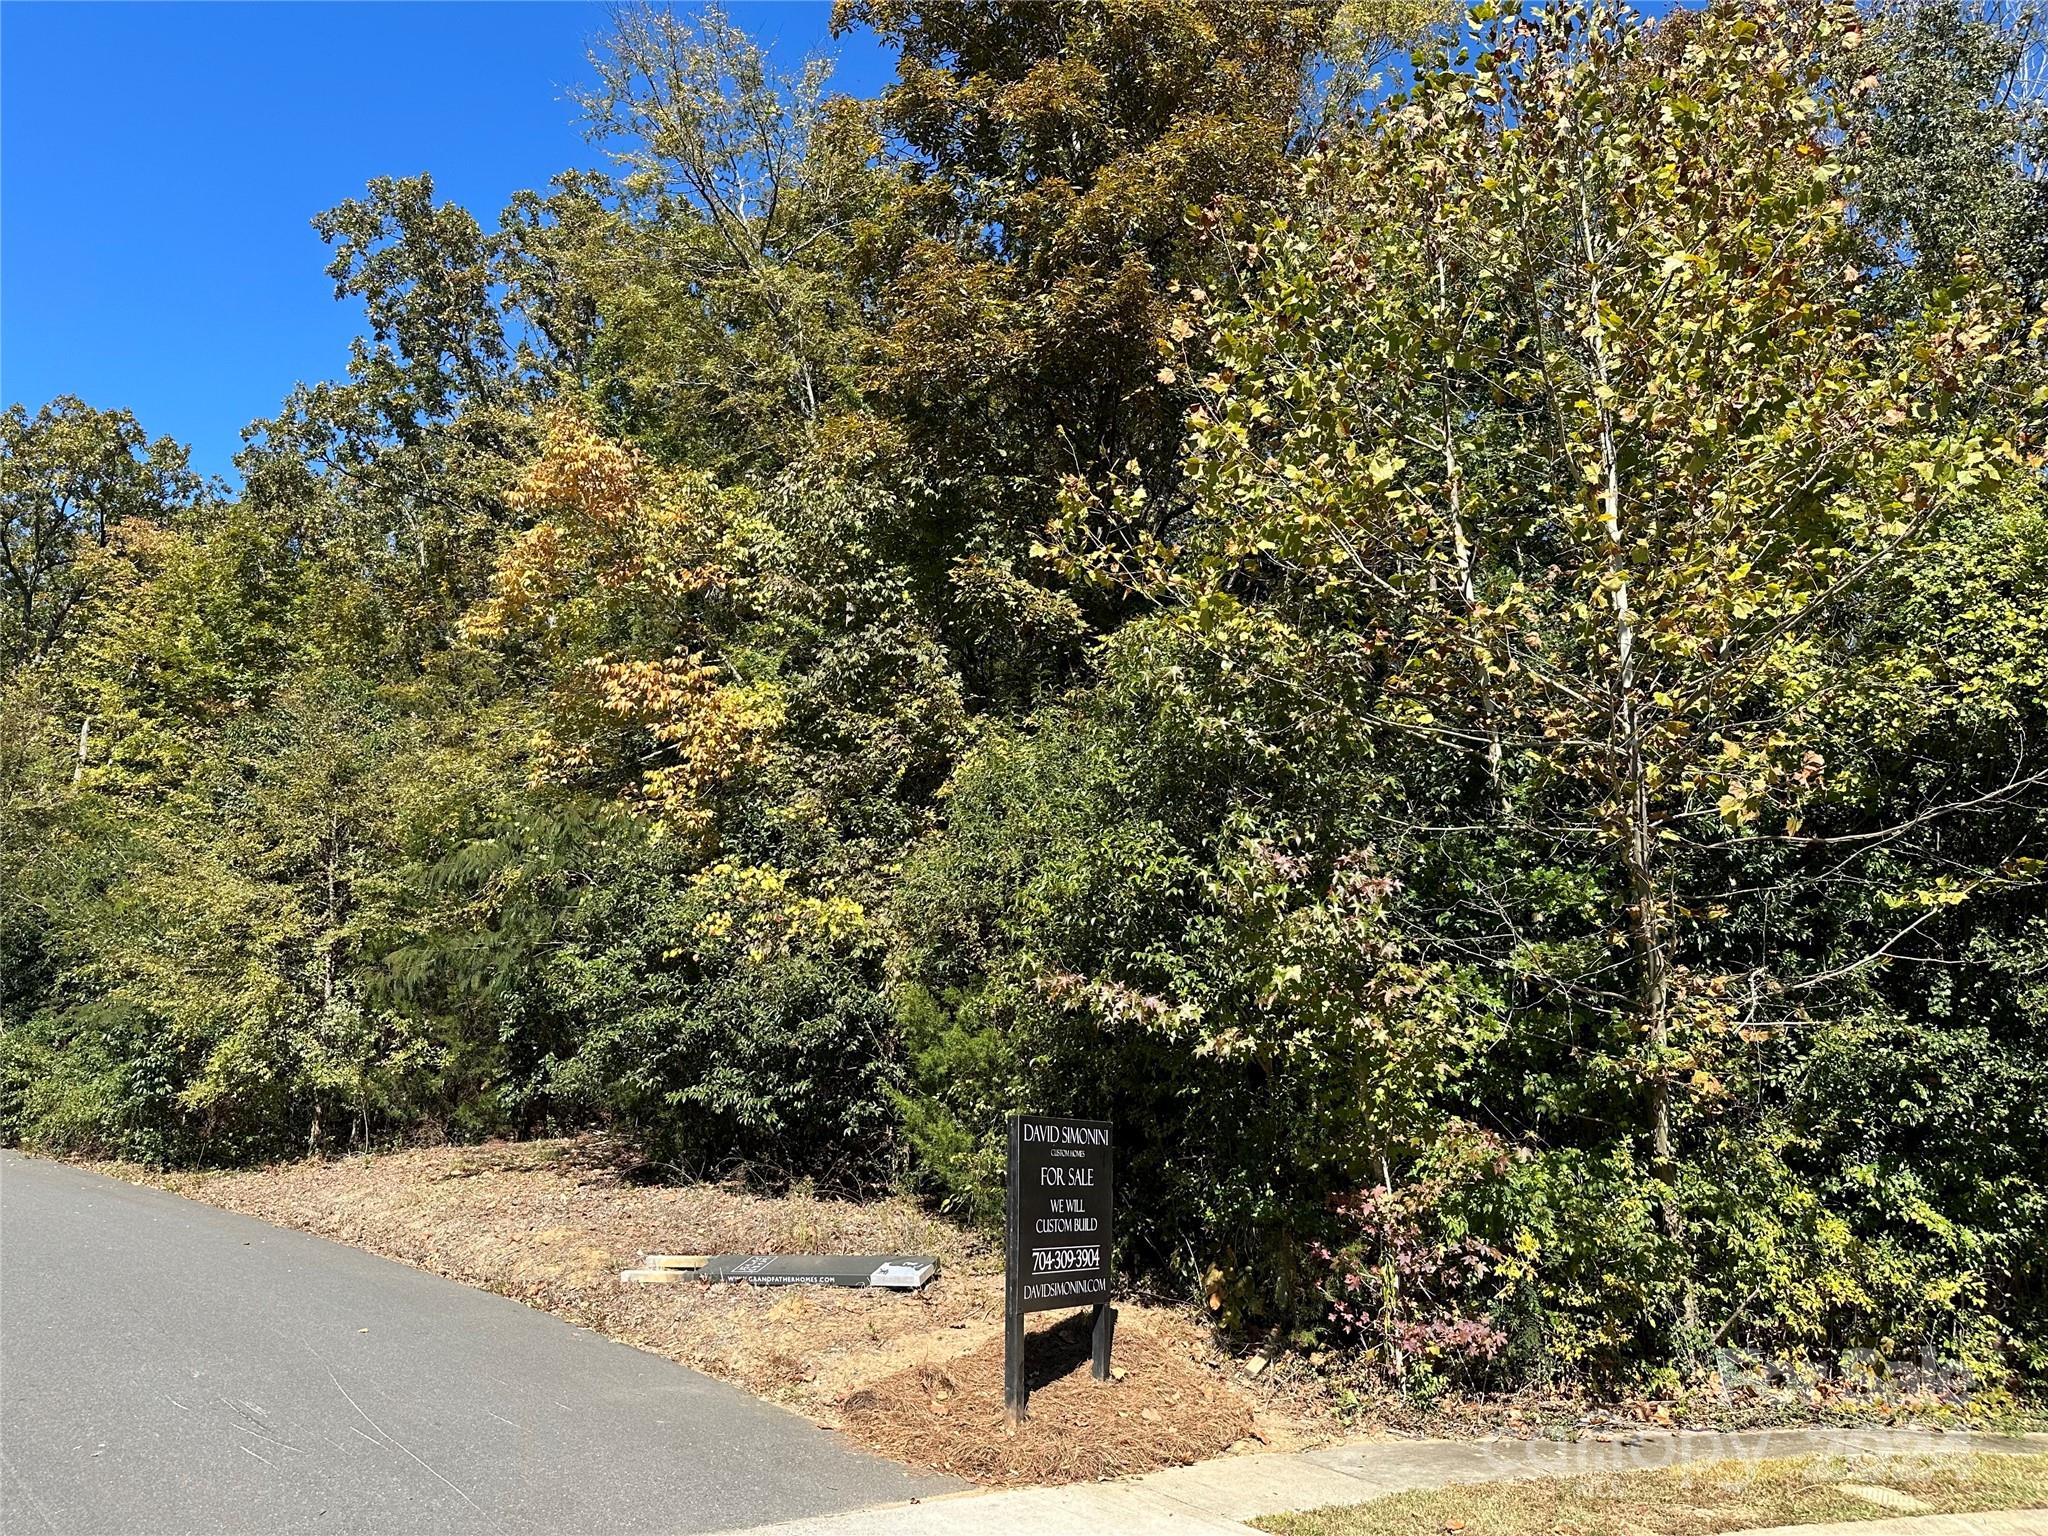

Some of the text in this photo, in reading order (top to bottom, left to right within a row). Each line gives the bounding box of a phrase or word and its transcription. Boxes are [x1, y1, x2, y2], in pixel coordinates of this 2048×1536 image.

[1023, 1123, 1109, 1146] DAVID SIMONINI
[1050, 1149, 1086, 1158] CUSTOM HOMES
[1040, 1167, 1094, 1186] FOR SALE
[1050, 1199, 1085, 1213] WE WILL
[1035, 1217, 1098, 1234] CUSTOM BUILD
[1032, 1248, 1100, 1271] 704-309-3904
[1023, 1278, 1106, 1300] DAVIDSIMONINI.COM
